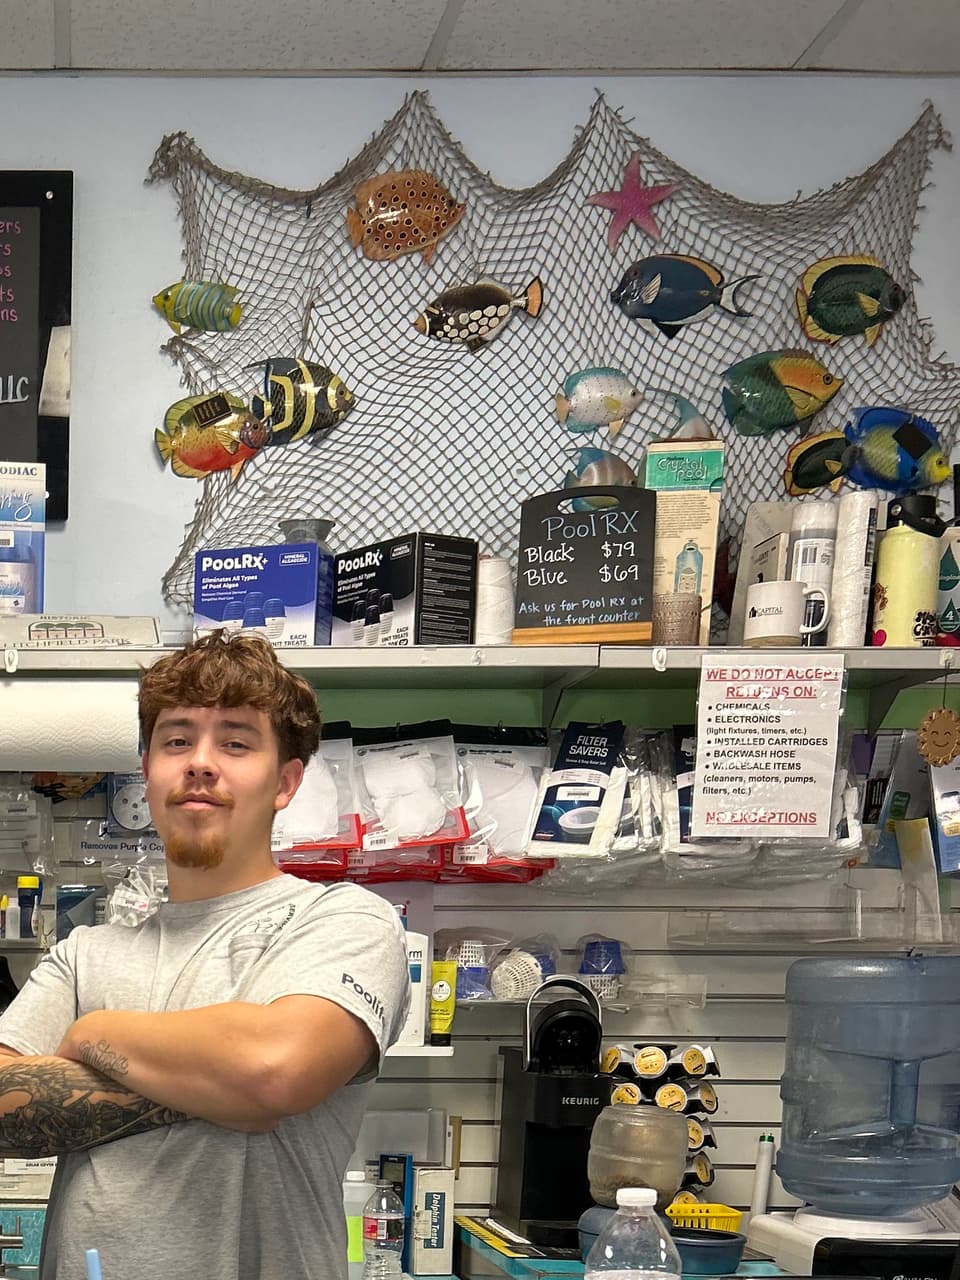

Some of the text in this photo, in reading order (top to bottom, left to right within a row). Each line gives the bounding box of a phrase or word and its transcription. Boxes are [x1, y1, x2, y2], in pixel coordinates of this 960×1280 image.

[658, 456, 704, 473] Crystal
[676, 465, 708, 482] pool
[541, 513, 596, 541] Pool
[600, 510, 639, 535] RX
[524, 541, 635, 563] Black $79
[523, 564, 639, 586] Blue $69
[519, 602, 540, 614] Ask
[544, 603, 556, 612] us
[560, 600, 579, 611] for
[582, 597, 605, 608] Pool
[631, 596, 644, 606] at
[757, 606, 784, 615] CAPITAL
[543, 610, 640, 626] the front counter
[707, 669, 727, 679] WE
[732, 669, 750, 679] DO
[755, 669, 782, 679] NOT
[794, 686, 817, 697] ON:
[706, 727, 807, 735] (light fixtures, timers, etc.)
[577, 736, 608, 747] FILTER
[569, 745, 608, 757] SAVERS
[714, 750, 796, 758] BACKWASH HOSE
[703, 775, 746, 783] (cleaners,
[784, 776, 816, 784] pumps,
[702, 787, 730, 795] filters,
[81, 841, 118, 850] Removes
[562, 1096, 599, 1106] KEURIG
